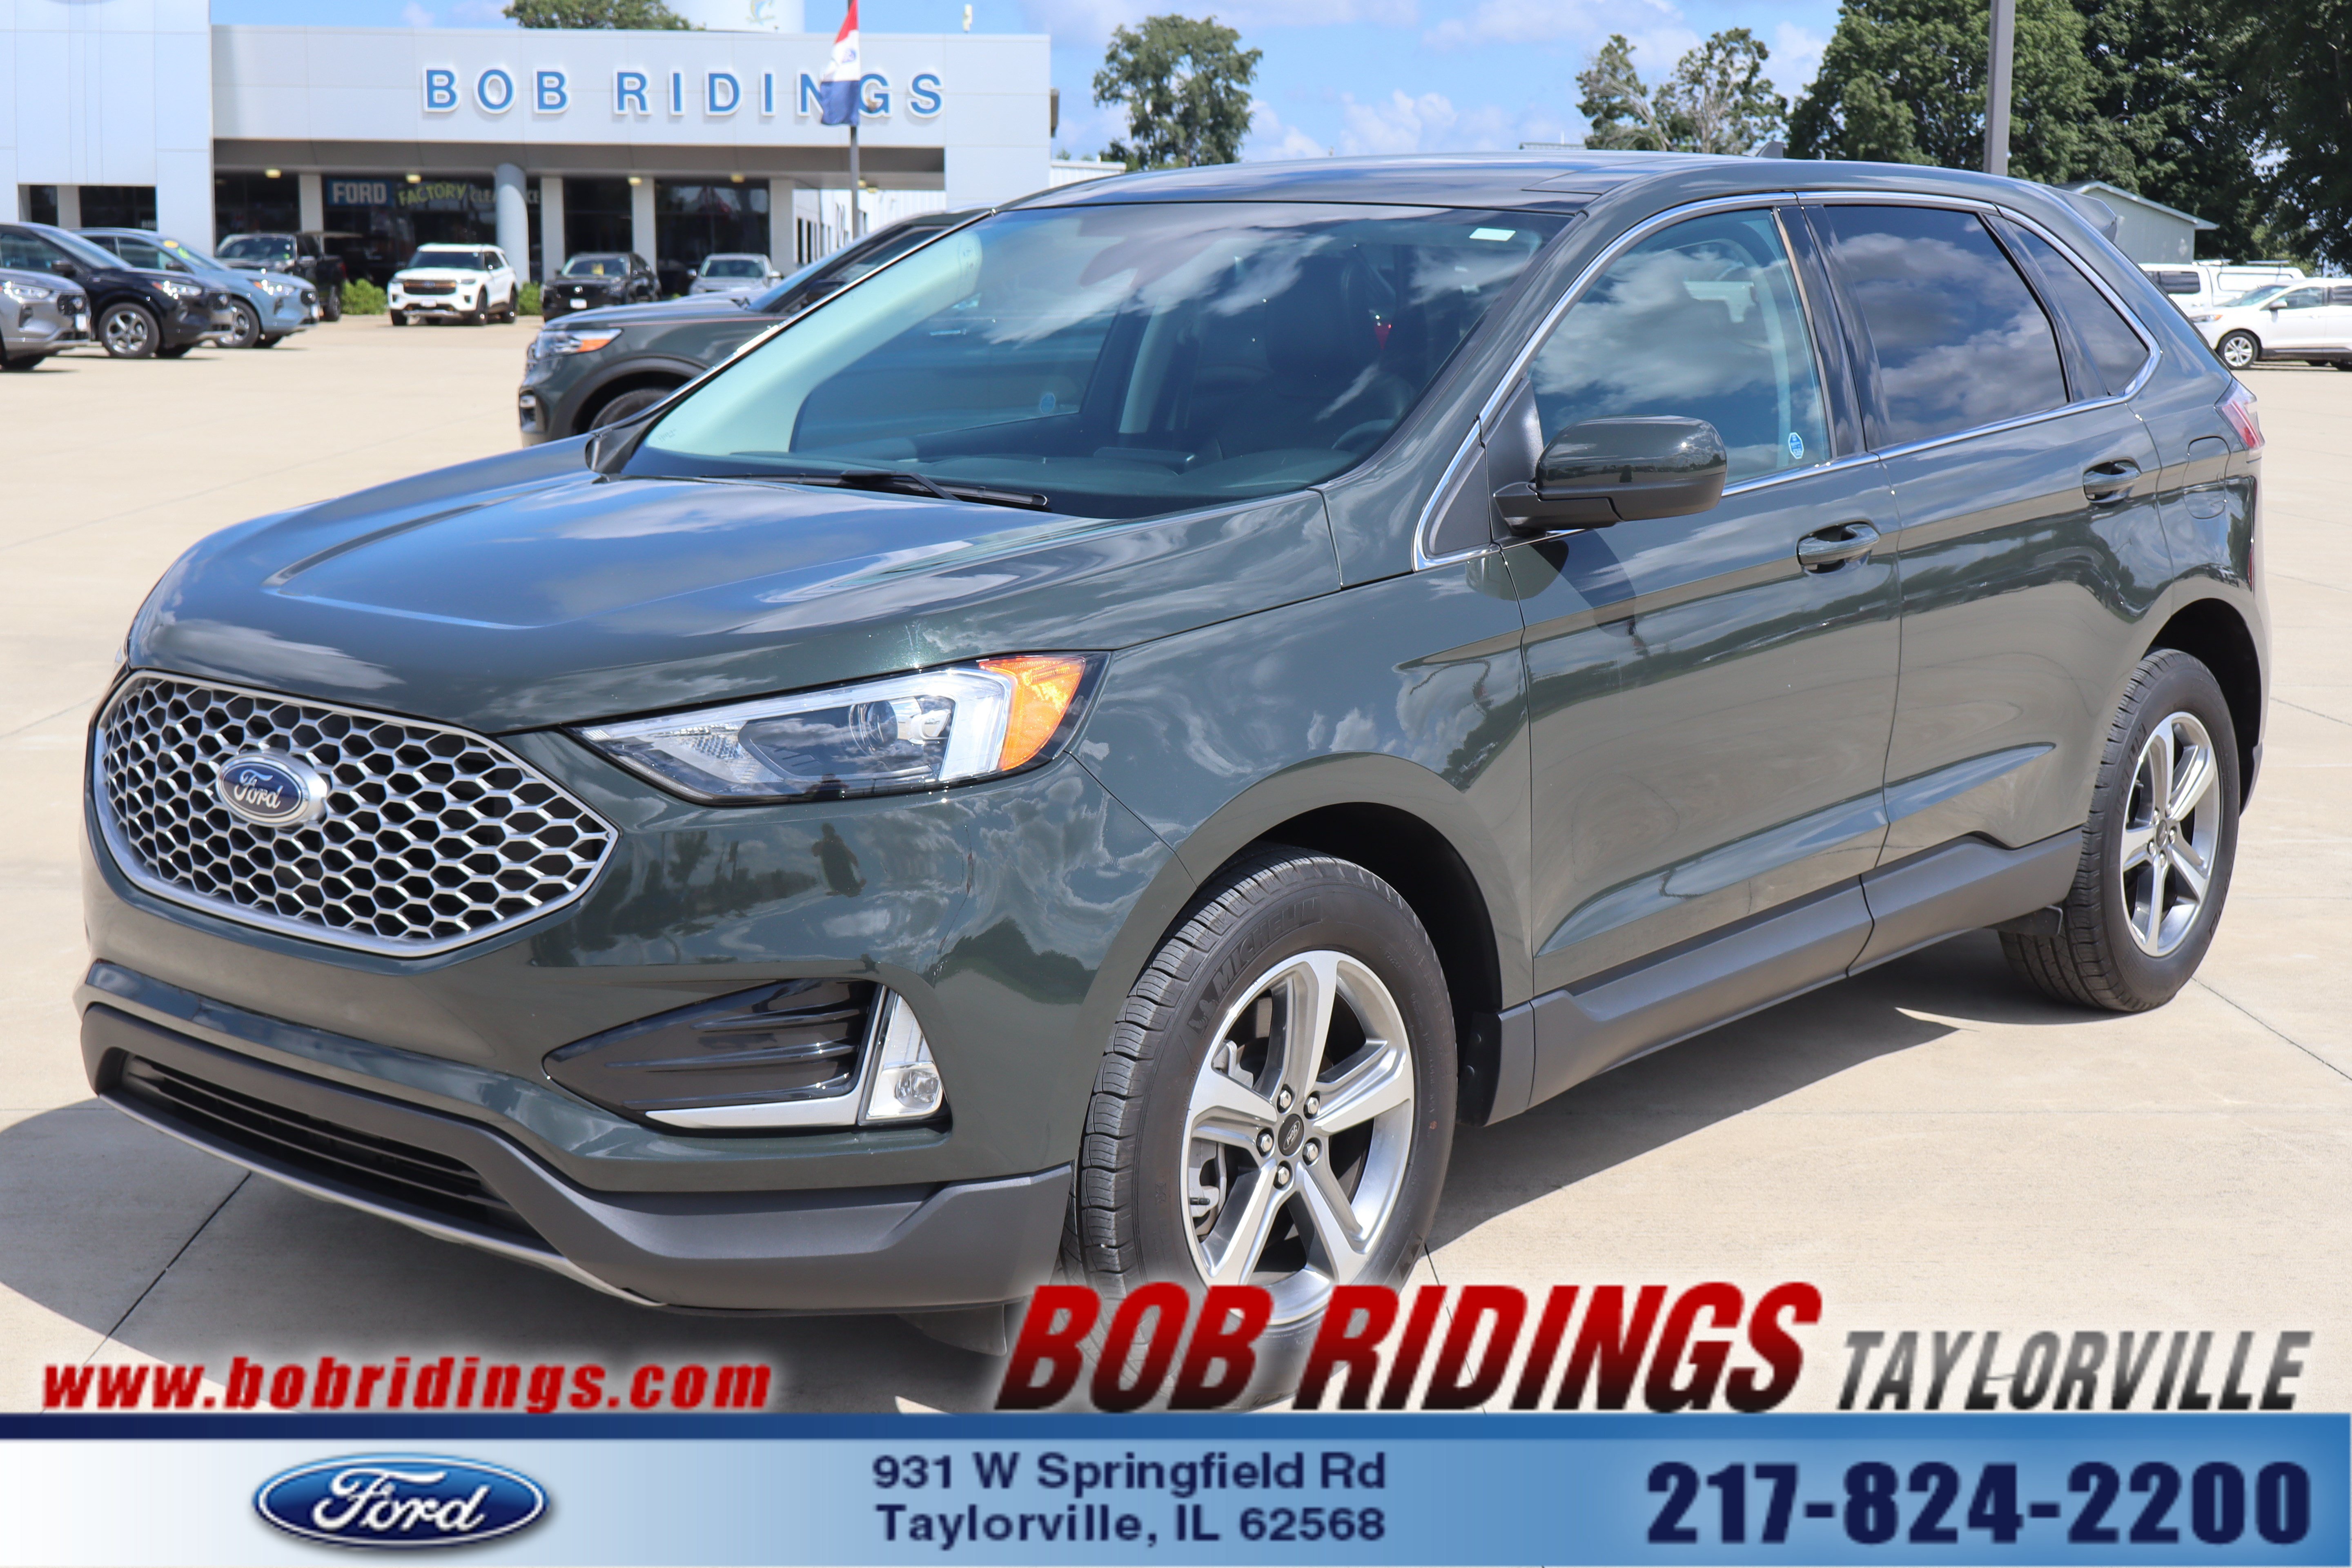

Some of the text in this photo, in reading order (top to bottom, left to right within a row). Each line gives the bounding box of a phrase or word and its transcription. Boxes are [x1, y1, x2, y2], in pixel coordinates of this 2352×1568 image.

[424, 67, 944, 118] BOB RIDINGS
[332, 182, 388, 204] FORD
[399, 181, 468, 207] FACTORY
[233, 769, 283, 809] Ford
[1212, 895, 1322, 993] MICHELIN
